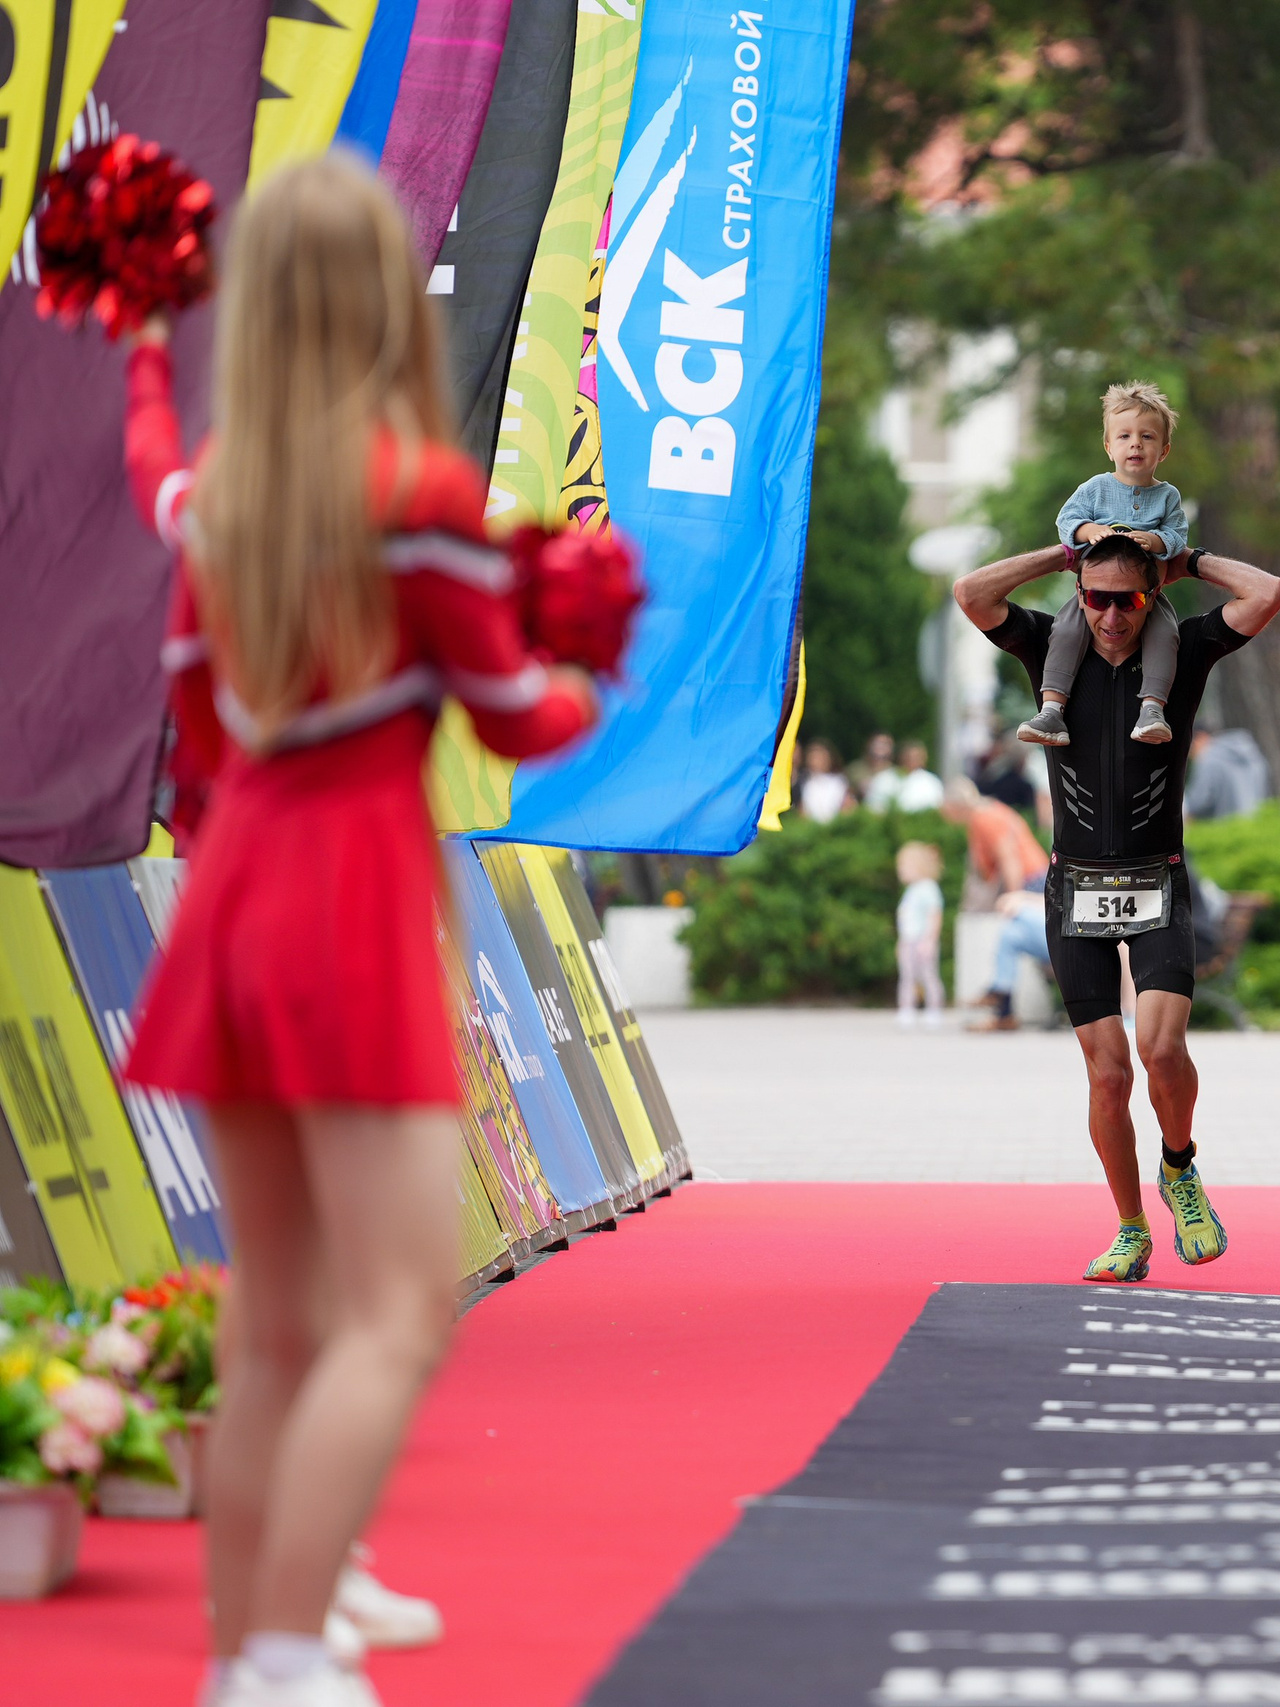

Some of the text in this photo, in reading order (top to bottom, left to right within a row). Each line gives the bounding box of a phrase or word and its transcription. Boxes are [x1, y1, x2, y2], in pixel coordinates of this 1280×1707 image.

[722, 10, 763, 249] СТРАХОВОЙ
[648, 247, 749, 497] ВСК
[1098, 896, 1137, 918] 514
[1118, 875, 1131, 883] STAR
